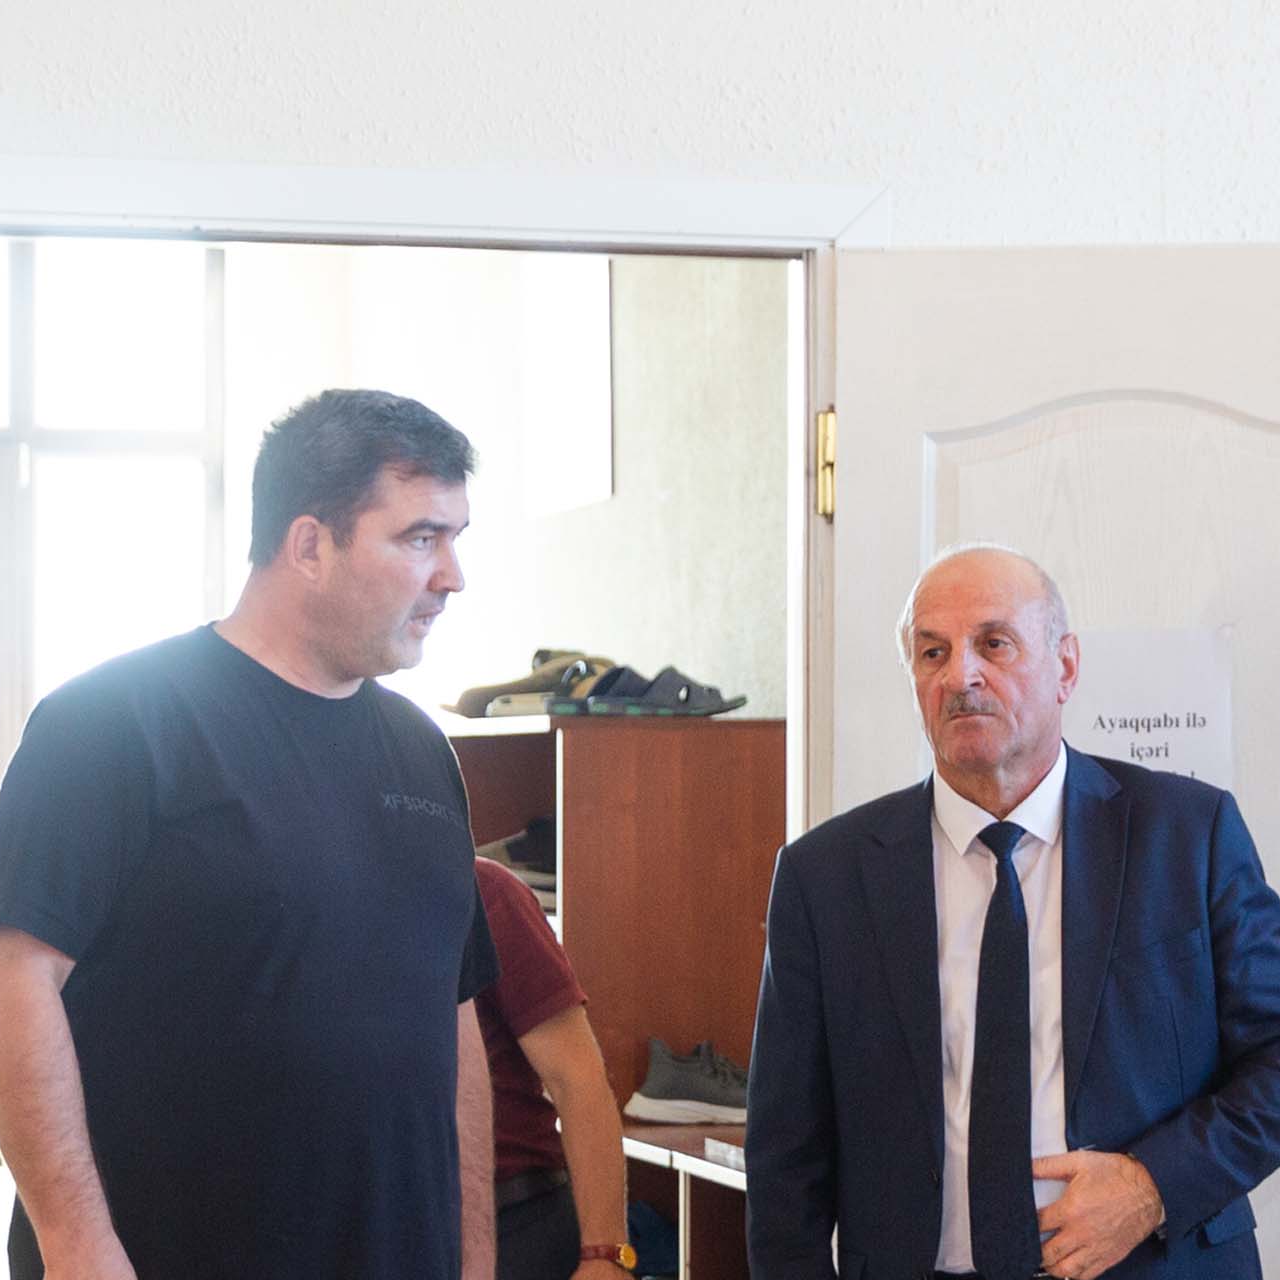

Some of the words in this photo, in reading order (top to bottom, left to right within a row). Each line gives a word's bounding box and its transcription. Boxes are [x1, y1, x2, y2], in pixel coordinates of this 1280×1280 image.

[1093, 713, 1179, 733] Ayaqqabı
[1186, 713, 1207, 728] ilə
[1130, 742, 1169, 759] içəri
